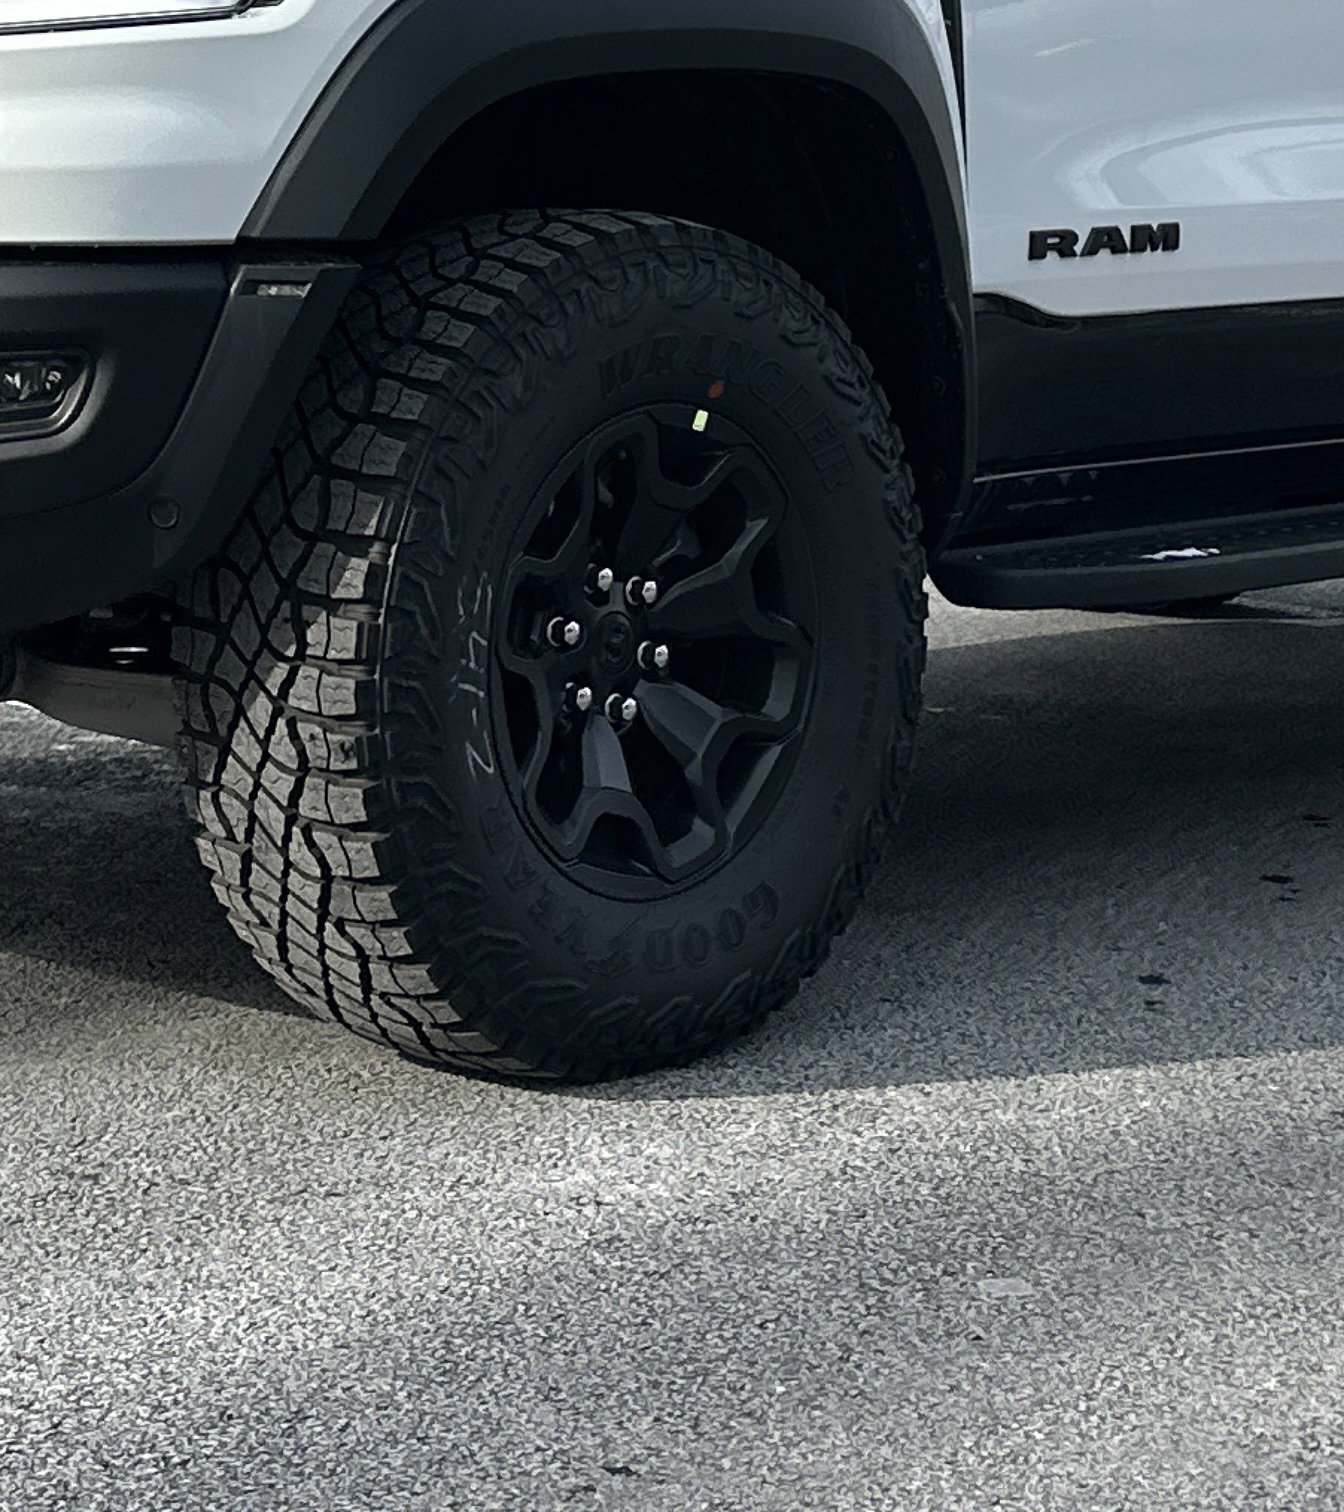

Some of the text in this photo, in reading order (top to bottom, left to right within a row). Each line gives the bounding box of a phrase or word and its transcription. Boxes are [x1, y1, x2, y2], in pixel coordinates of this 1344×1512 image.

[1027, 222, 1181, 261] RAM
[598, 332, 855, 492] WRANGLER
[478, 796, 780, 978] GOODYEAR
